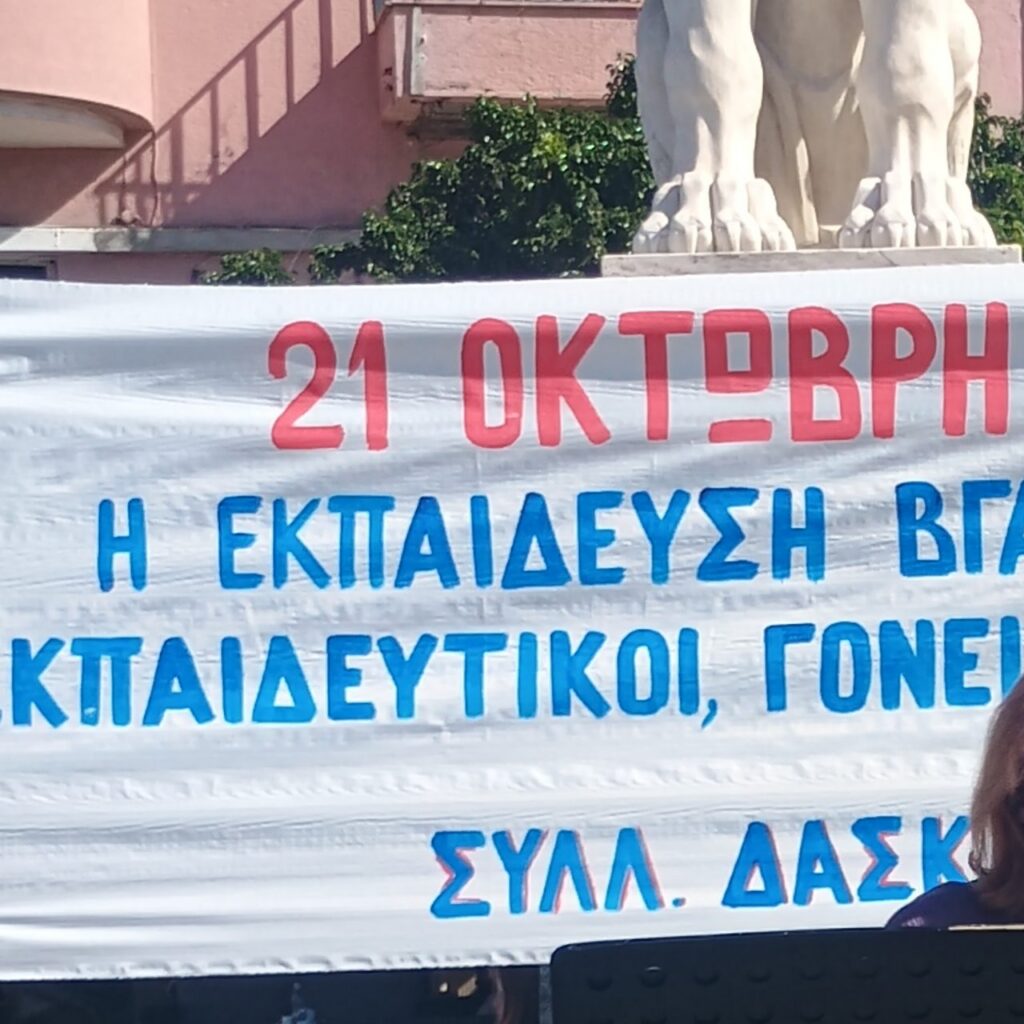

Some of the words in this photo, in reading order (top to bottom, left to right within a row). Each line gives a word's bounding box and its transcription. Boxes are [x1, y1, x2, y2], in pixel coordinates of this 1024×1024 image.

[267, 320, 390, 451] 21
[460, 301, 1009, 449] ΟΚΤΩΒΡΗ
[95, 496, 149, 592] Η
[215, 484, 827, 592] ΕΚΠΑΙΔΕΥΣΗ
[0, 626, 719, 729] ΚΠΑΙΔΕΥΤΙΚΟΙ,
[429, 826, 687, 920] ΣΥΛΛ.
[720, 814, 970, 908] ΔΑΣΚ
